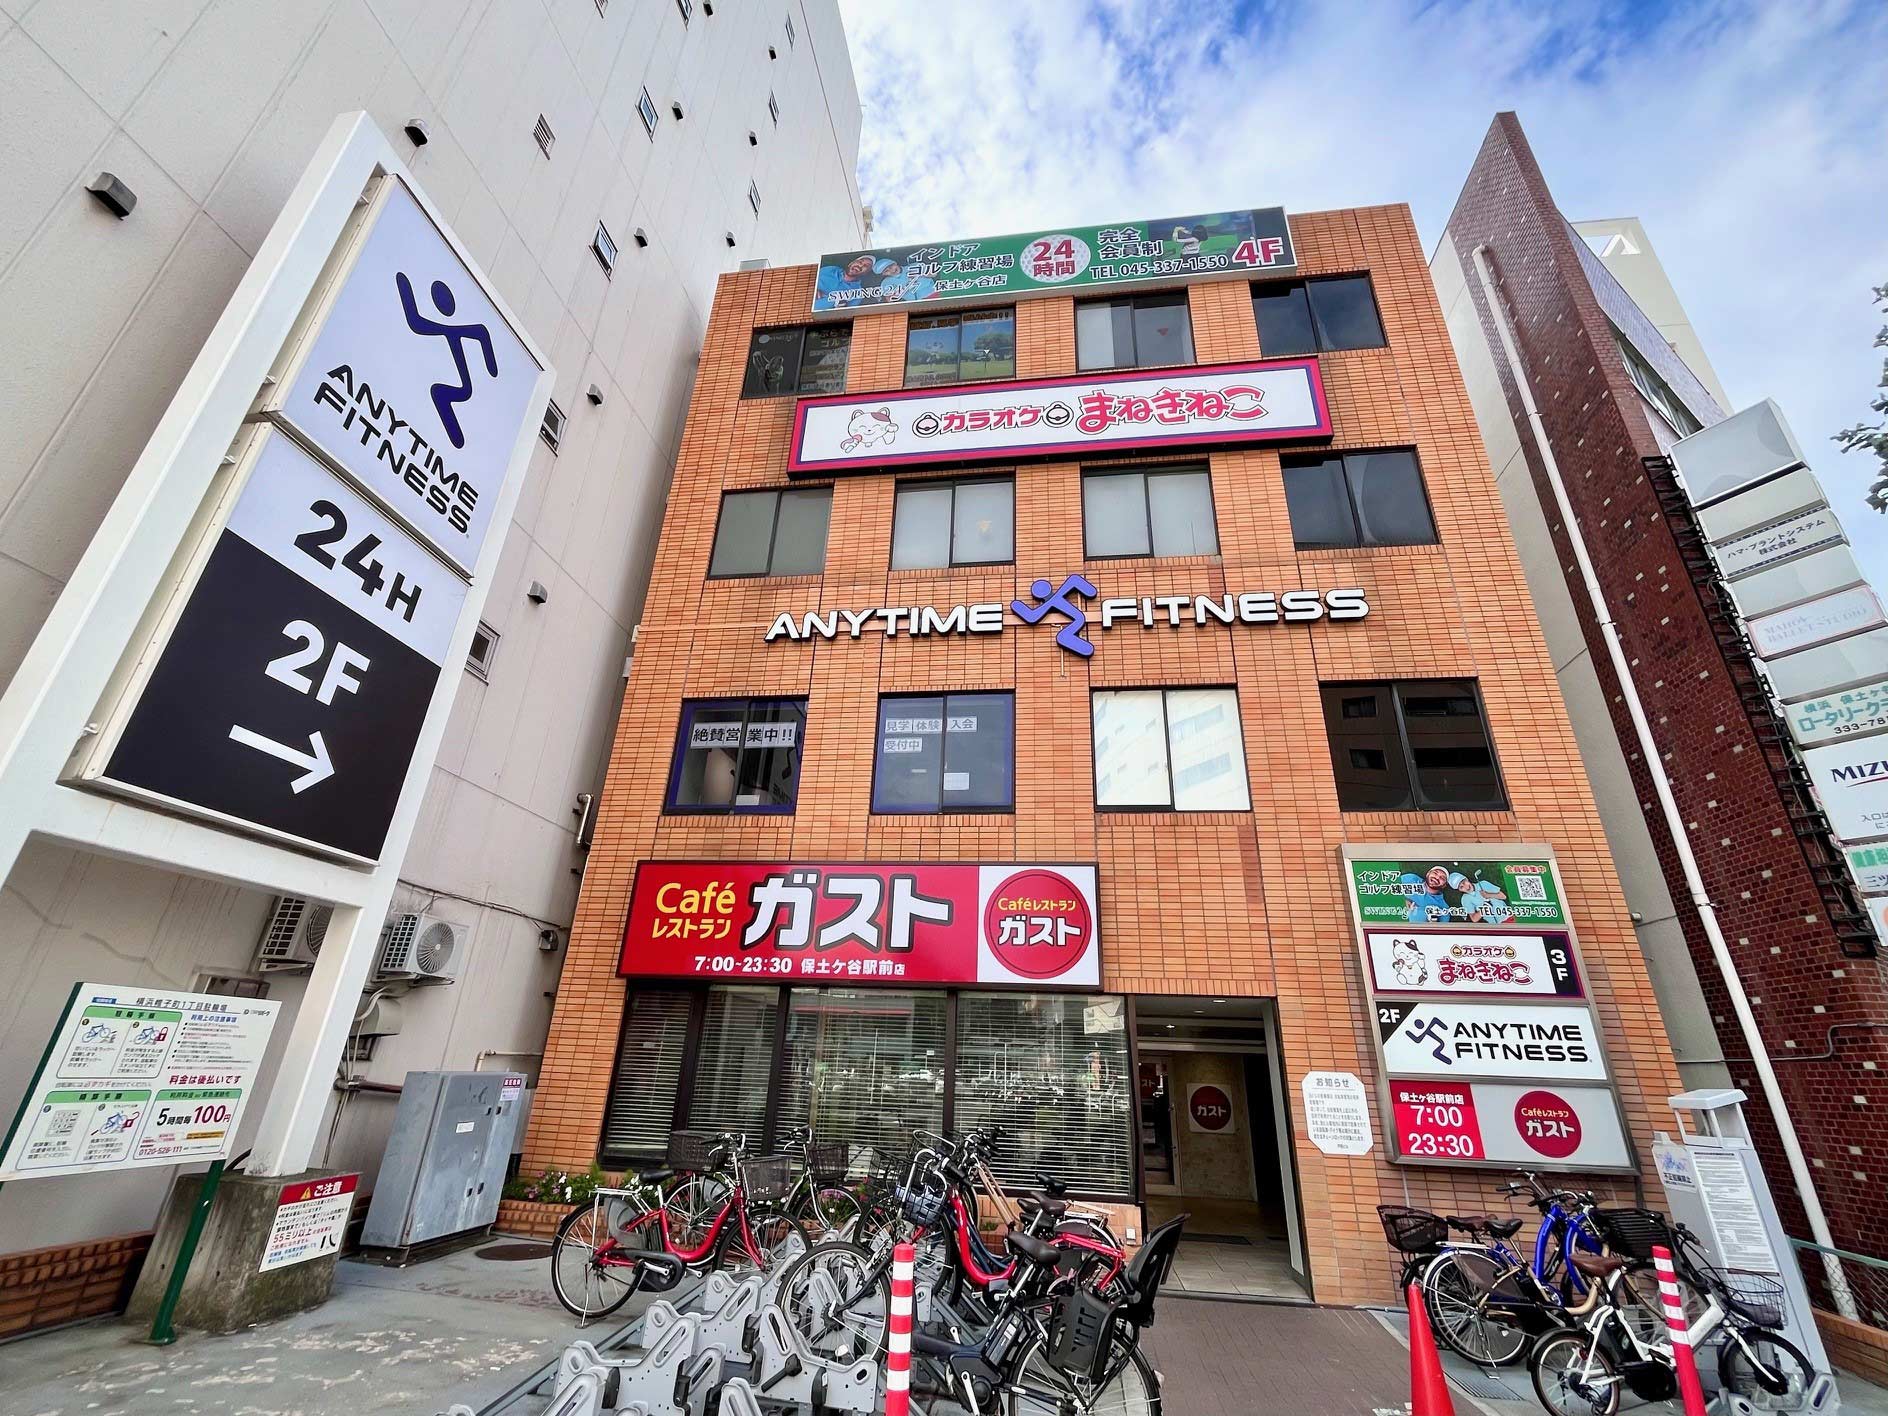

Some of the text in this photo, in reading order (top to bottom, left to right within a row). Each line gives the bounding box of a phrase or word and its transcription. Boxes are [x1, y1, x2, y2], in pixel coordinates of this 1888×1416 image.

[1098, 226, 1141, 244] 完全
[909, 240, 981, 263] インドア
[1032, 238, 1076, 262] 24
[1100, 239, 1164, 261] 会員制
[1232, 236, 1284, 268] 4F
[906, 252, 1014, 280] ゴルフ練習場
[1033, 259, 1077, 278] 時間
[1090, 254, 1229, 281] TEL 045-337-1550
[939, 382, 1270, 437] カラオケ まねきねこ
[326, 364, 480, 511] ANYTIME
[313, 381, 469, 535] FITNESS
[293, 499, 423, 623] 24H
[764, 587, 1371, 643] ANYTIME FITNESS
[264, 619, 371, 706] 2F
[885, 740, 920, 751] 受付中
[1356, 870, 1401, 884] インドア
[1504, 864, 1547, 875] 会員募集中
[655, 881, 735, 915] Café
[1358, 883, 1426, 897] ゴルフ練習場
[742, 870, 954, 951] ガスト
[997, 896, 1077, 913] Caféレストラン
[1479, 905, 1559, 919] TEL 045-337-1550
[652, 917, 734, 940] レストラン
[998, 914, 1082, 947] ガスト
[1462, 944, 1504, 957] カラオケ
[1437, 957, 1534, 987] まねきねこ
[1379, 1008, 1401, 1024] 2F
[1453, 1021, 1584, 1042] ANYTIME
[1453, 1041, 1589, 1063] FITNESS
[1315, 1077, 1350, 1088] お知らせ
[1196, 1104, 1227, 1118] ガスト
[1409, 1105, 1463, 1128] 7:00
[1525, 1120, 1576, 1139] ガスト
[1407, 1132, 1475, 1157] 23:30
[313, 1181, 342, 1197] ご注意
